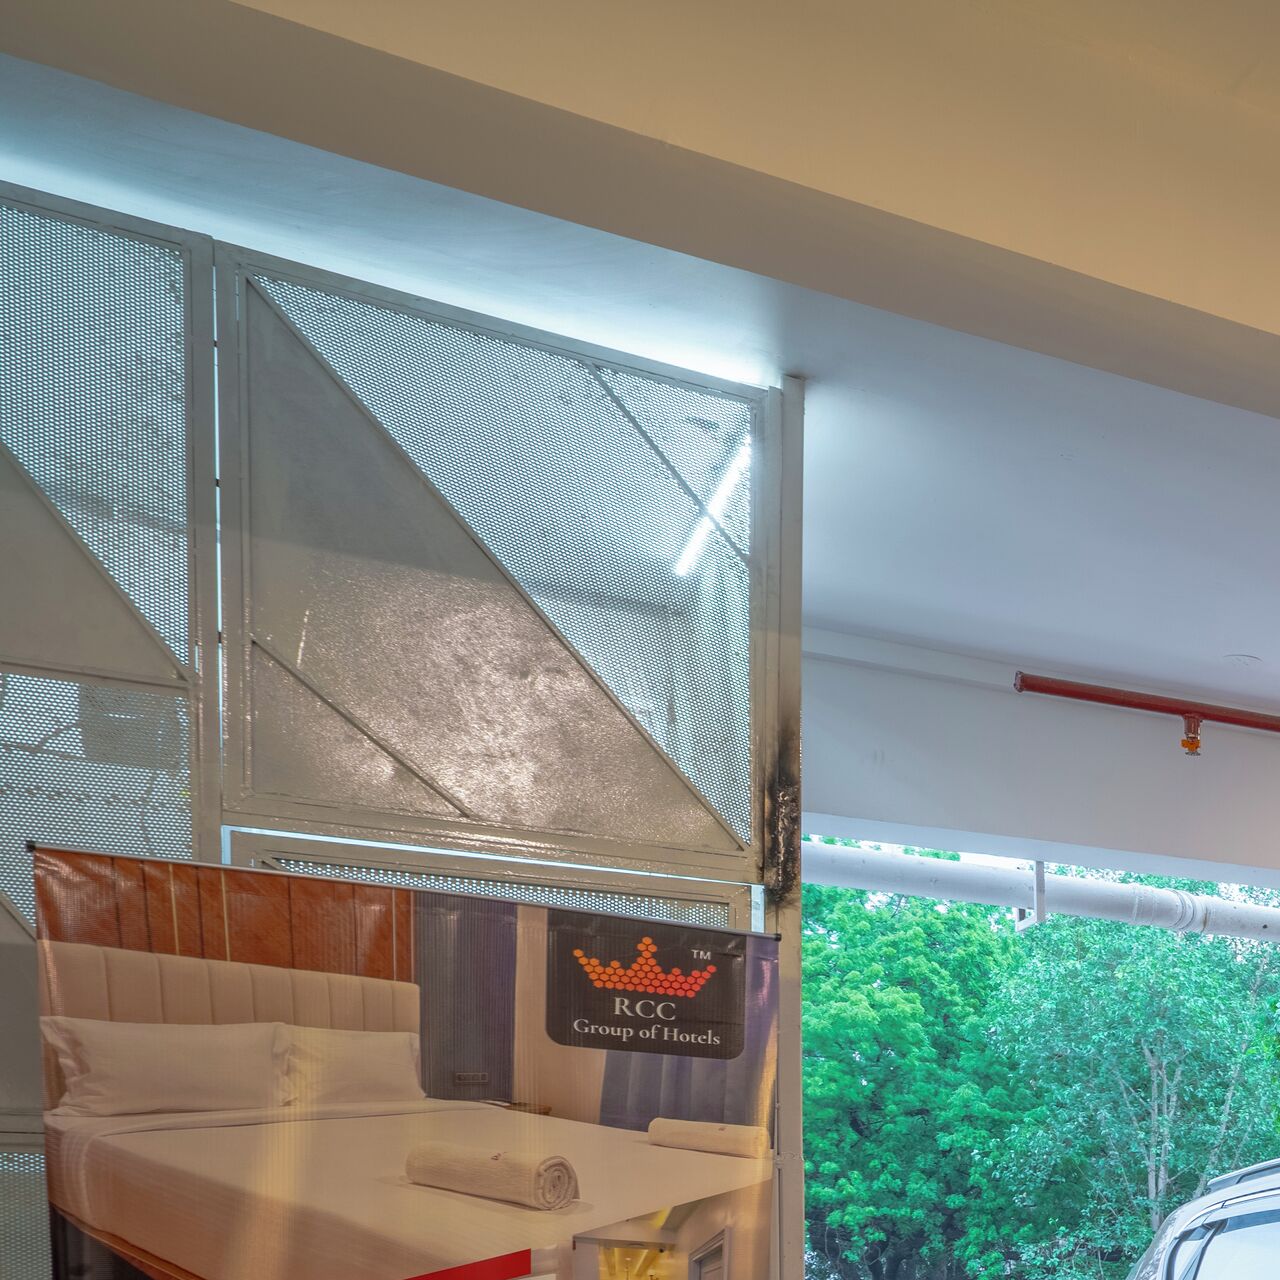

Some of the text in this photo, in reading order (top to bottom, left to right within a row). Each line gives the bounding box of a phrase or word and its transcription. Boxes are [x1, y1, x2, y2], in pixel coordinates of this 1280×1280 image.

[691, 949, 711, 961] TM
[613, 997, 676, 1021] RCC
[573, 1018, 721, 1046] Group of Hotels
